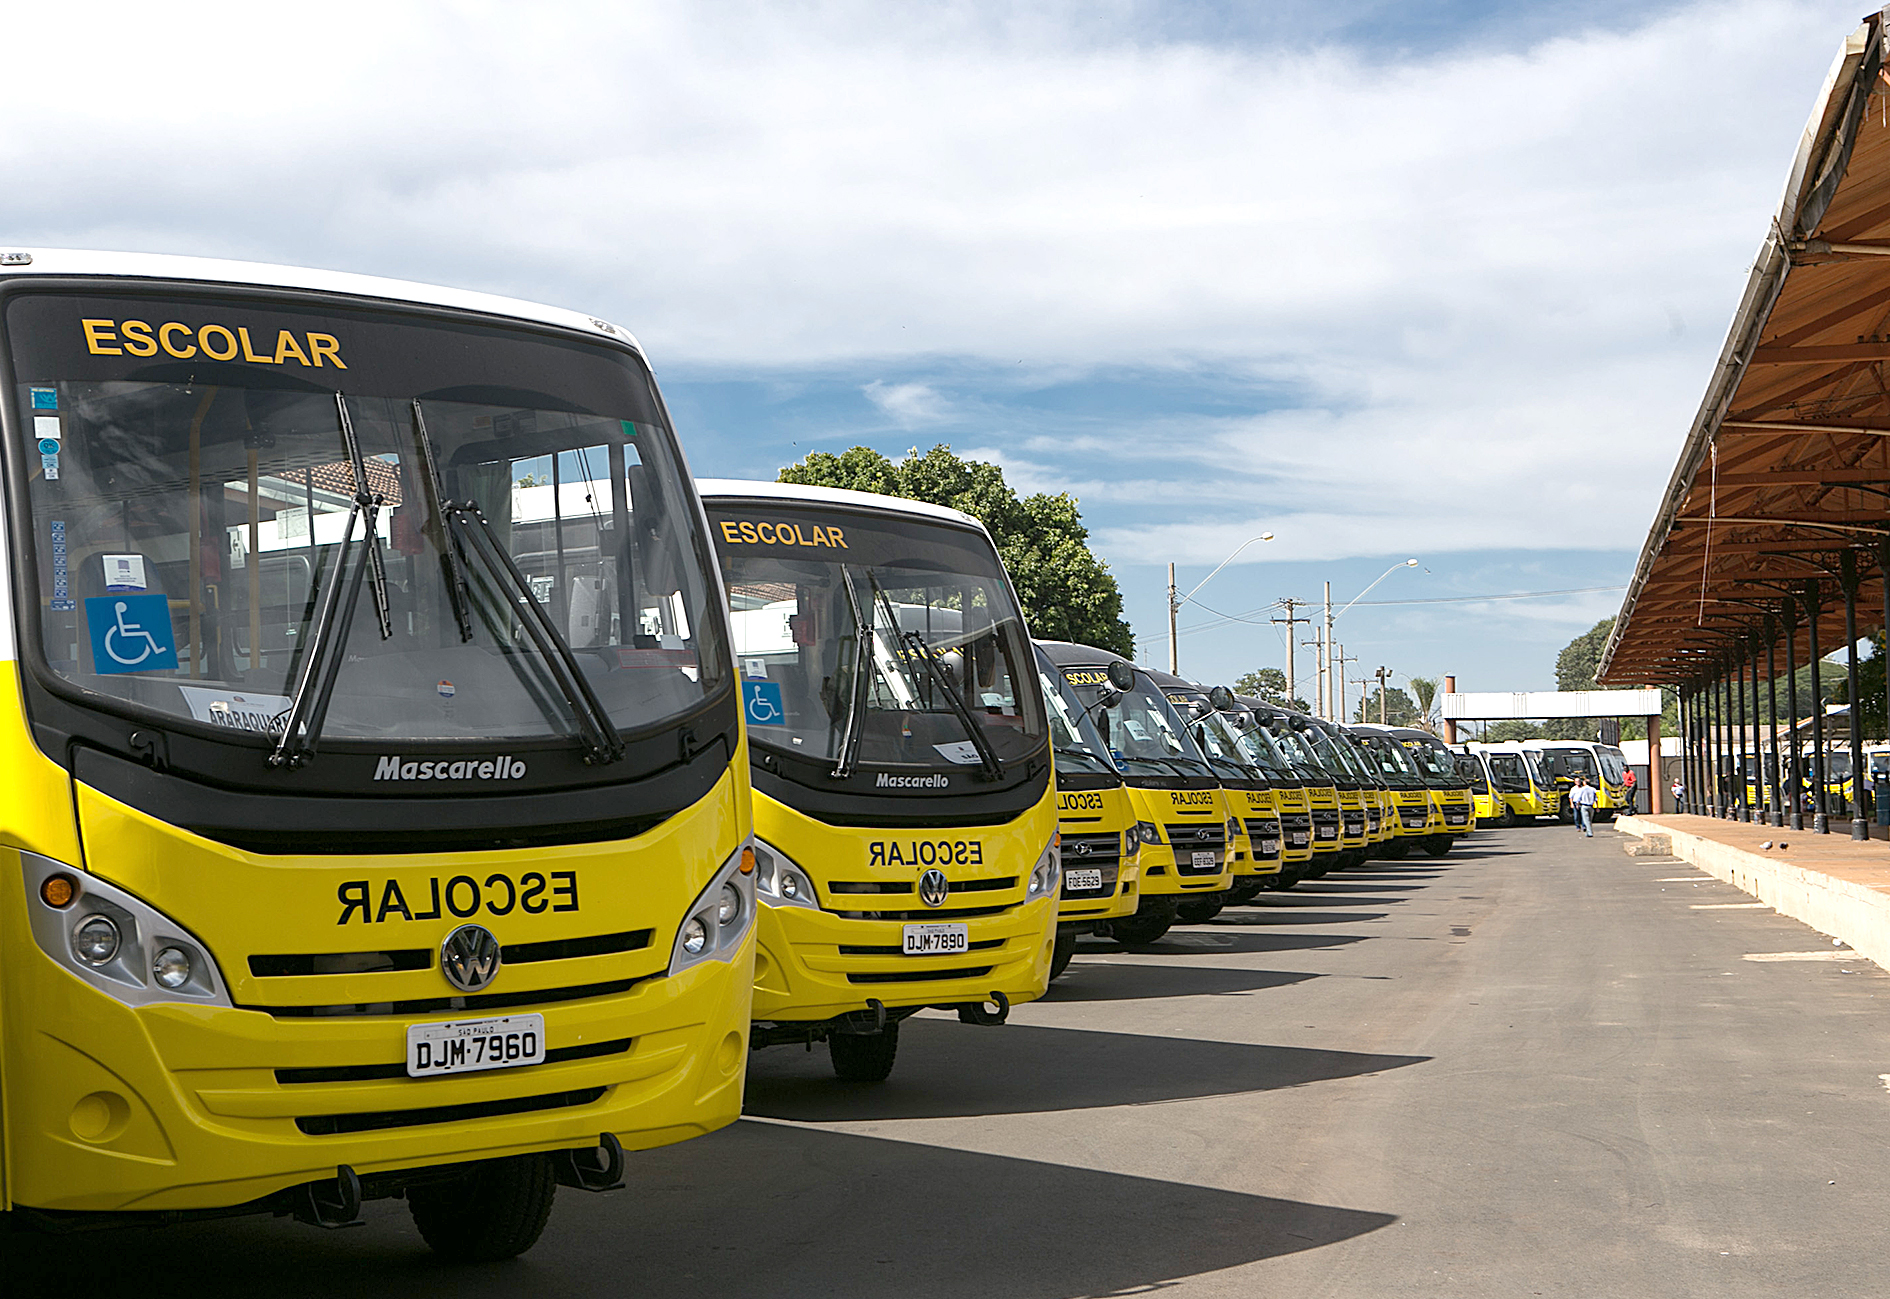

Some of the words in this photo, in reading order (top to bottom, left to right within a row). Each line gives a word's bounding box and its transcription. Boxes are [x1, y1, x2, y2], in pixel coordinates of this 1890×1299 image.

[81, 318, 348, 370] ESCOLAR
[719, 521, 849, 549] ESCOLAR
[1065, 672, 1109, 685] SCOLAR
[373, 756, 526, 781] Mascarello
[876, 773, 949, 788] Mascarello
